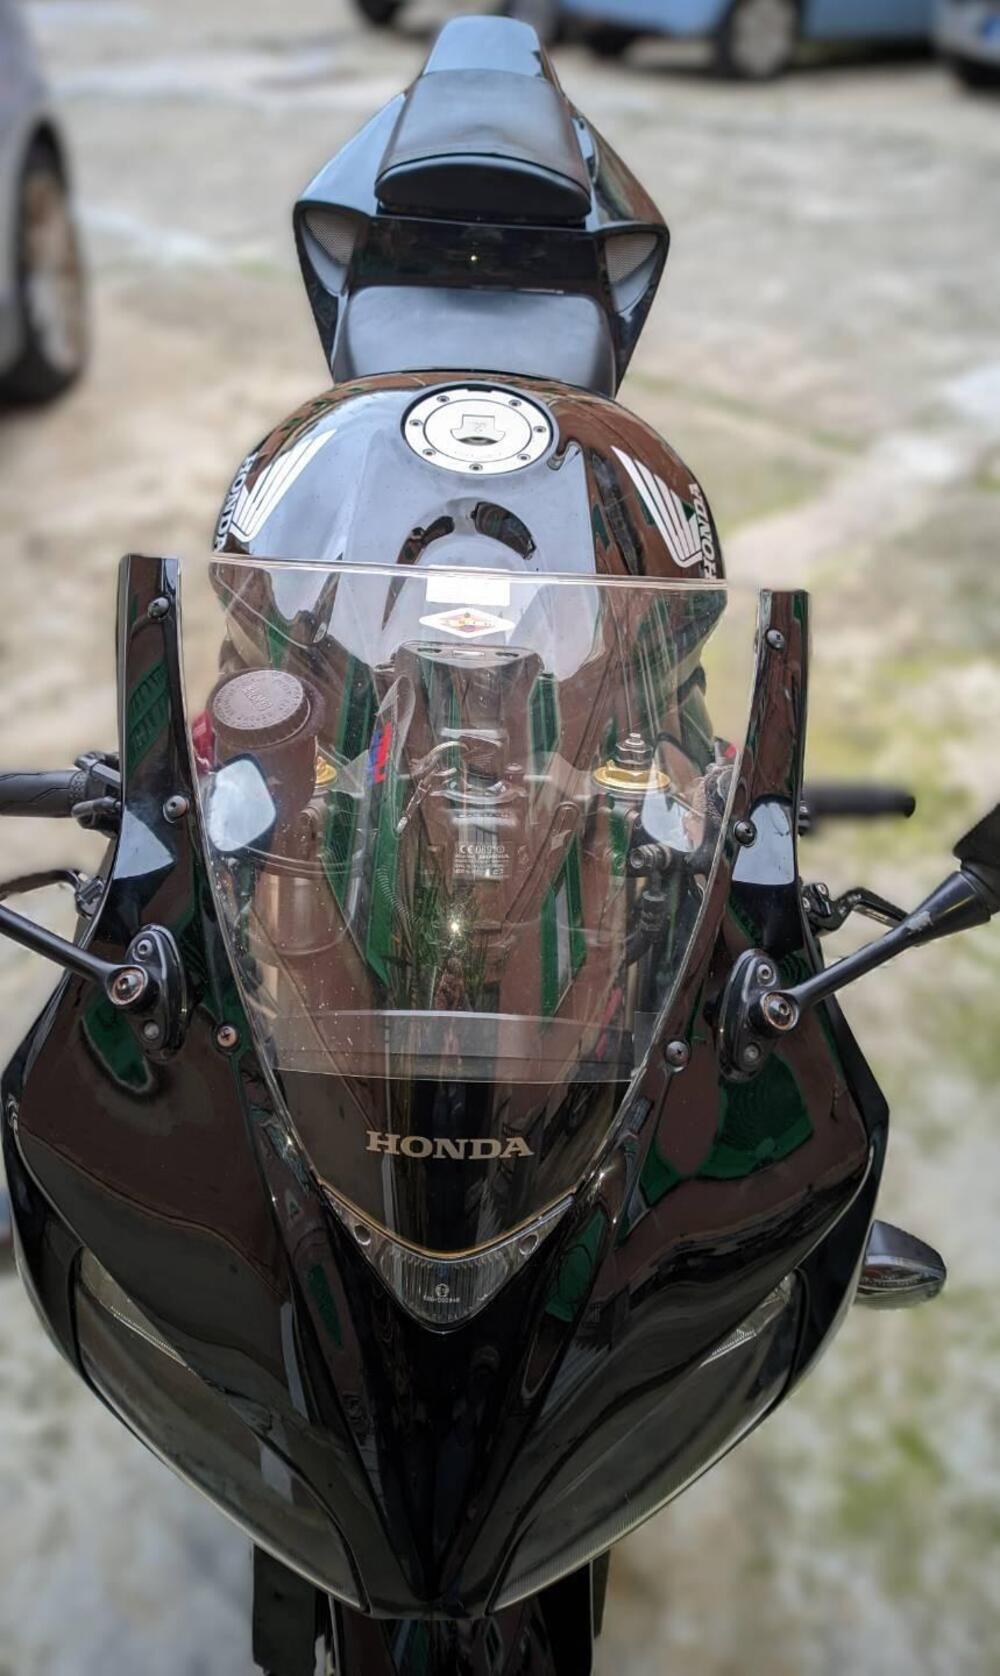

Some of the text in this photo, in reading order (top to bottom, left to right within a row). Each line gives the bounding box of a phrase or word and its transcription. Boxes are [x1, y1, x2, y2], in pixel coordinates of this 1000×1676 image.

[215, 452, 259, 552] HONDA
[688, 483, 717, 580] HONDA
[365, 1130, 535, 1160] HONDA
